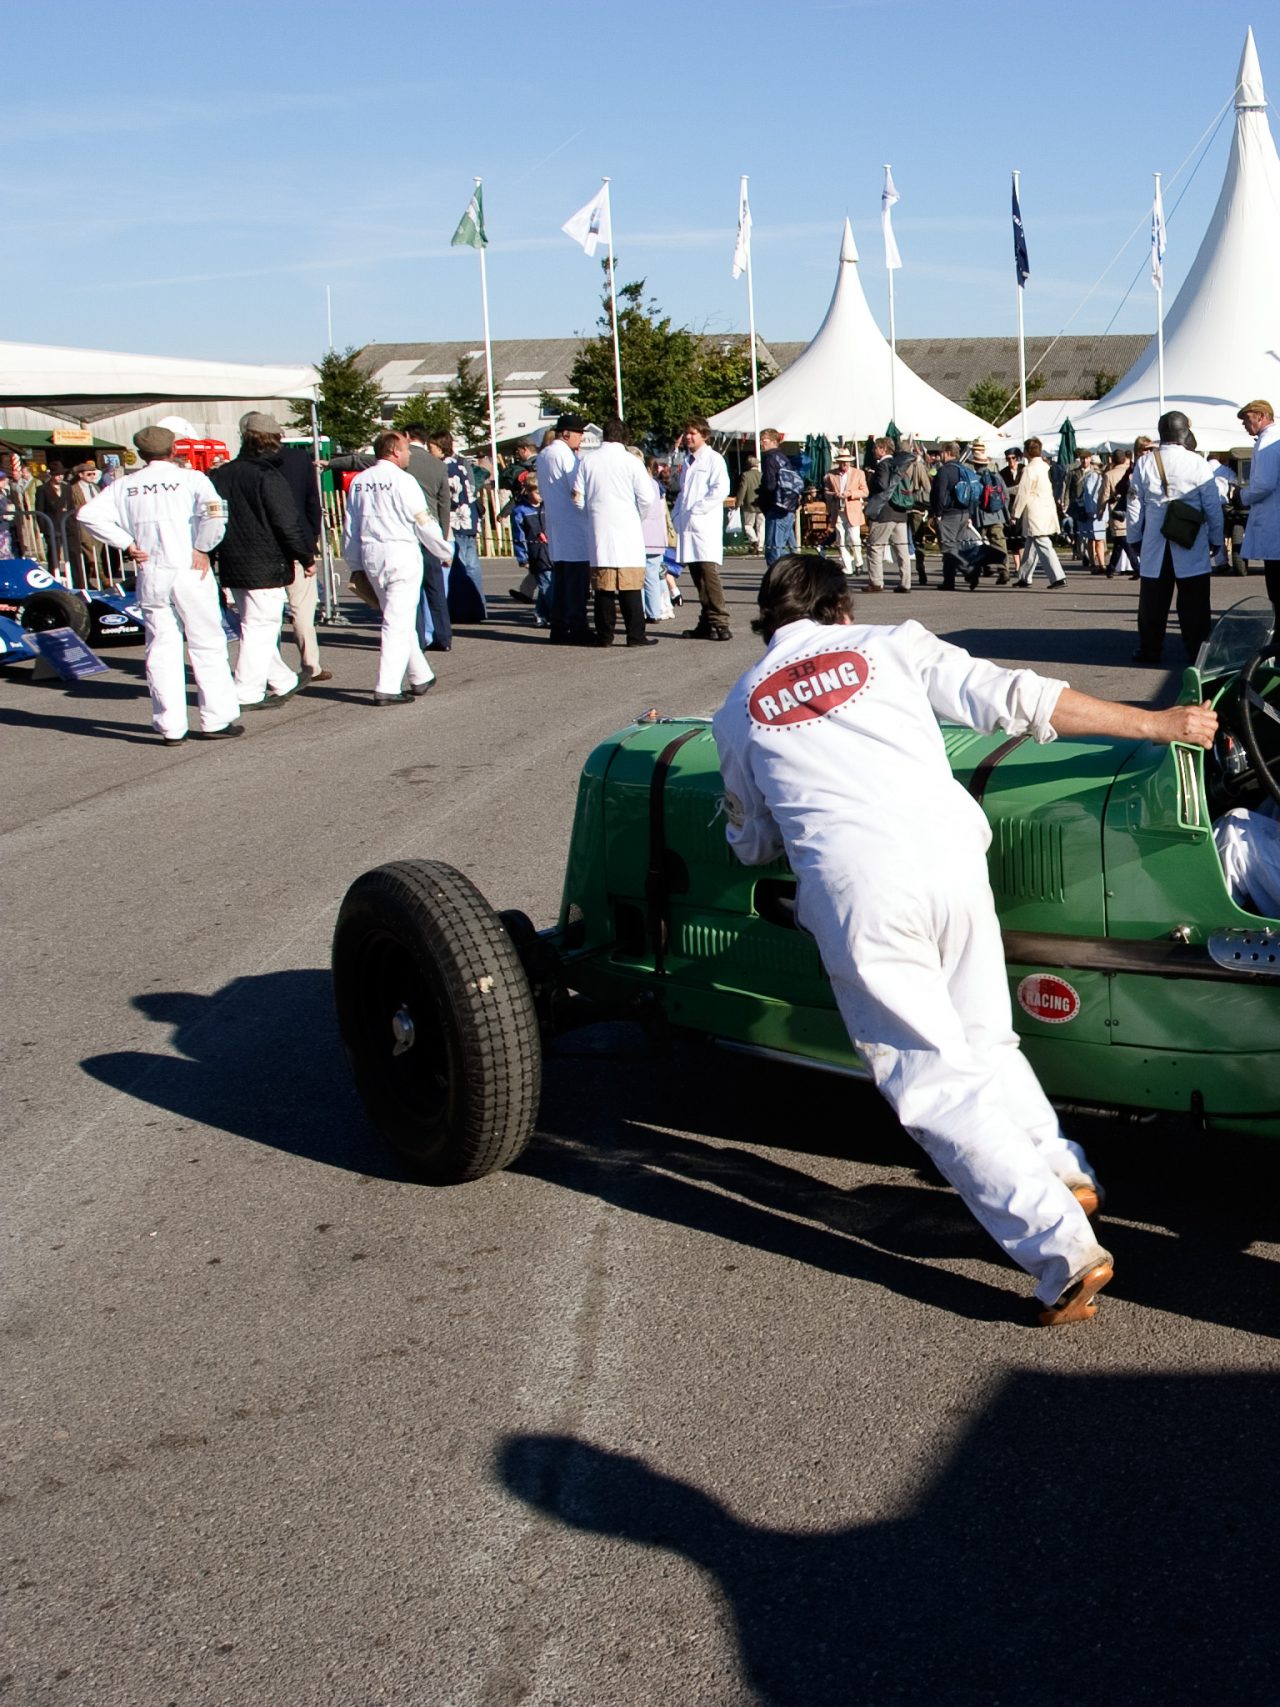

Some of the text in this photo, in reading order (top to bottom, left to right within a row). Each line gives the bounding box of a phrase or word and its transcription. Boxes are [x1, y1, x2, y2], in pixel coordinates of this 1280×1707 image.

[127, 483, 180, 496] BMW
[355, 483, 392, 492] BMW
[758, 662, 861, 720] RACING
[1026, 990, 1070, 1012] RACING
